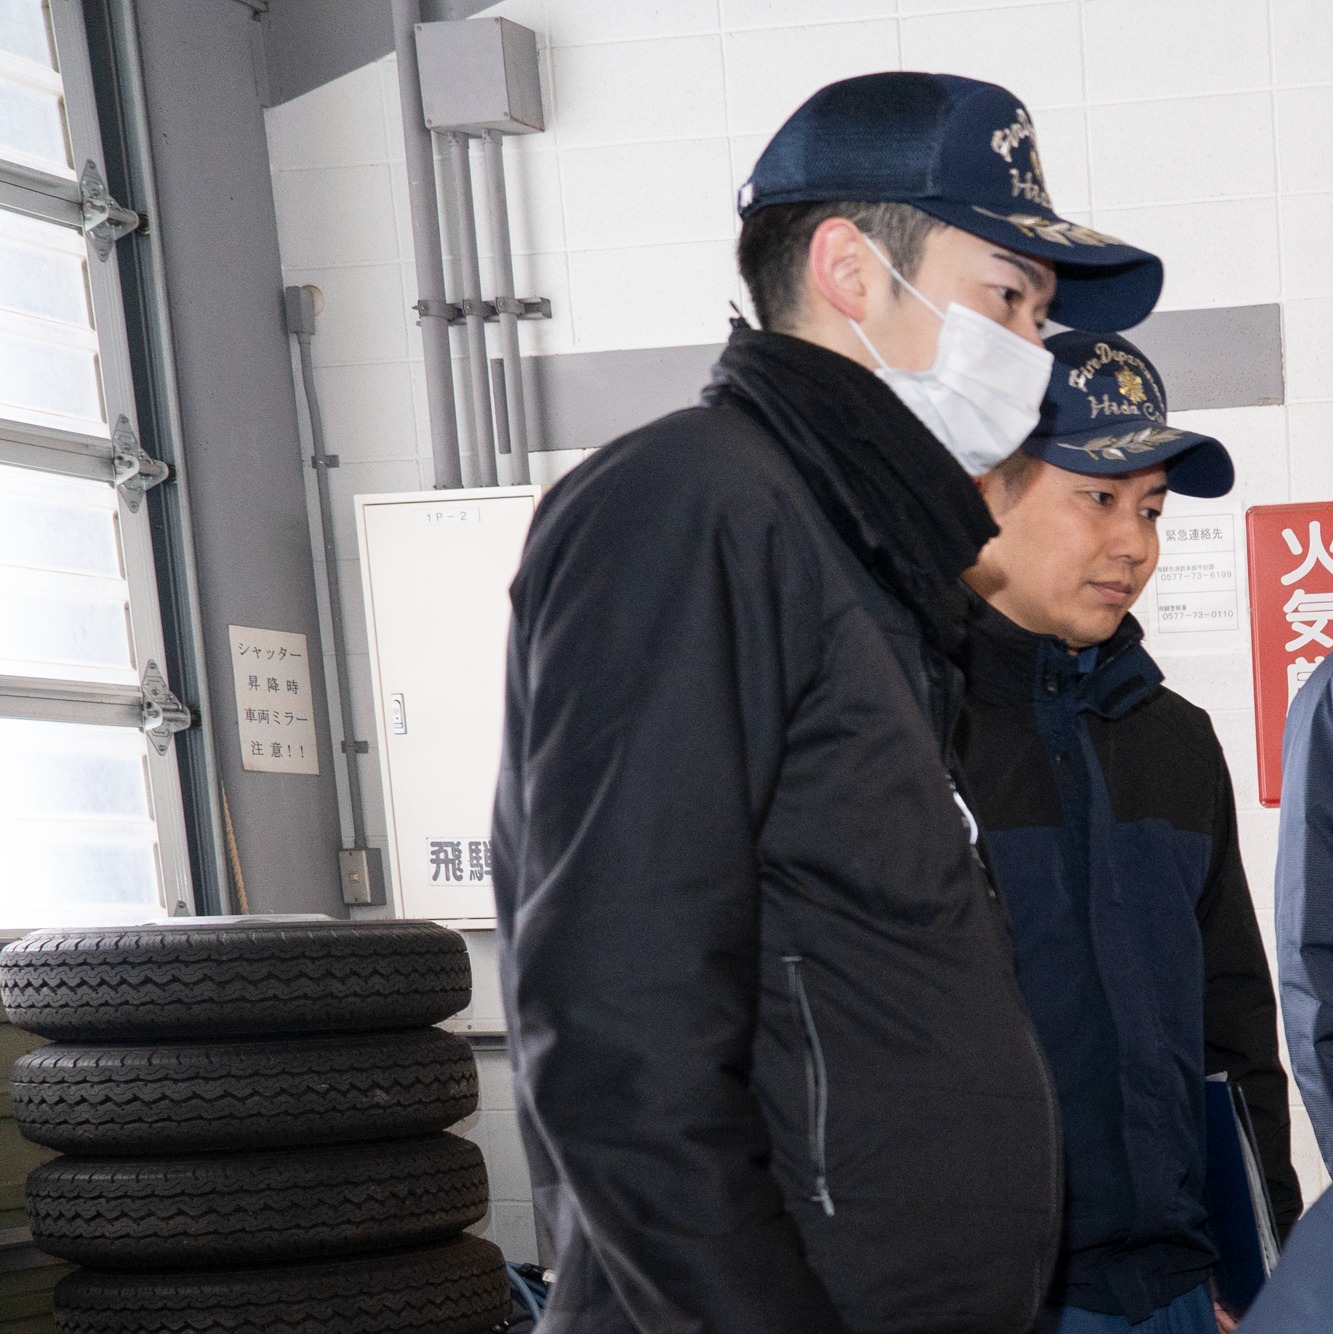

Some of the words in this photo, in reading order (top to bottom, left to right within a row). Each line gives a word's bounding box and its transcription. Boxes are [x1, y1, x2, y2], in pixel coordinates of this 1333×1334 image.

[1068, 357, 1102, 393] Fire
[1087, 394, 1141, 419] Hida
[1165, 527, 1224, 542] 緊急連絡先
[237, 642, 302, 661] シャッター
[244, 707, 308, 726] 車両ミラー
